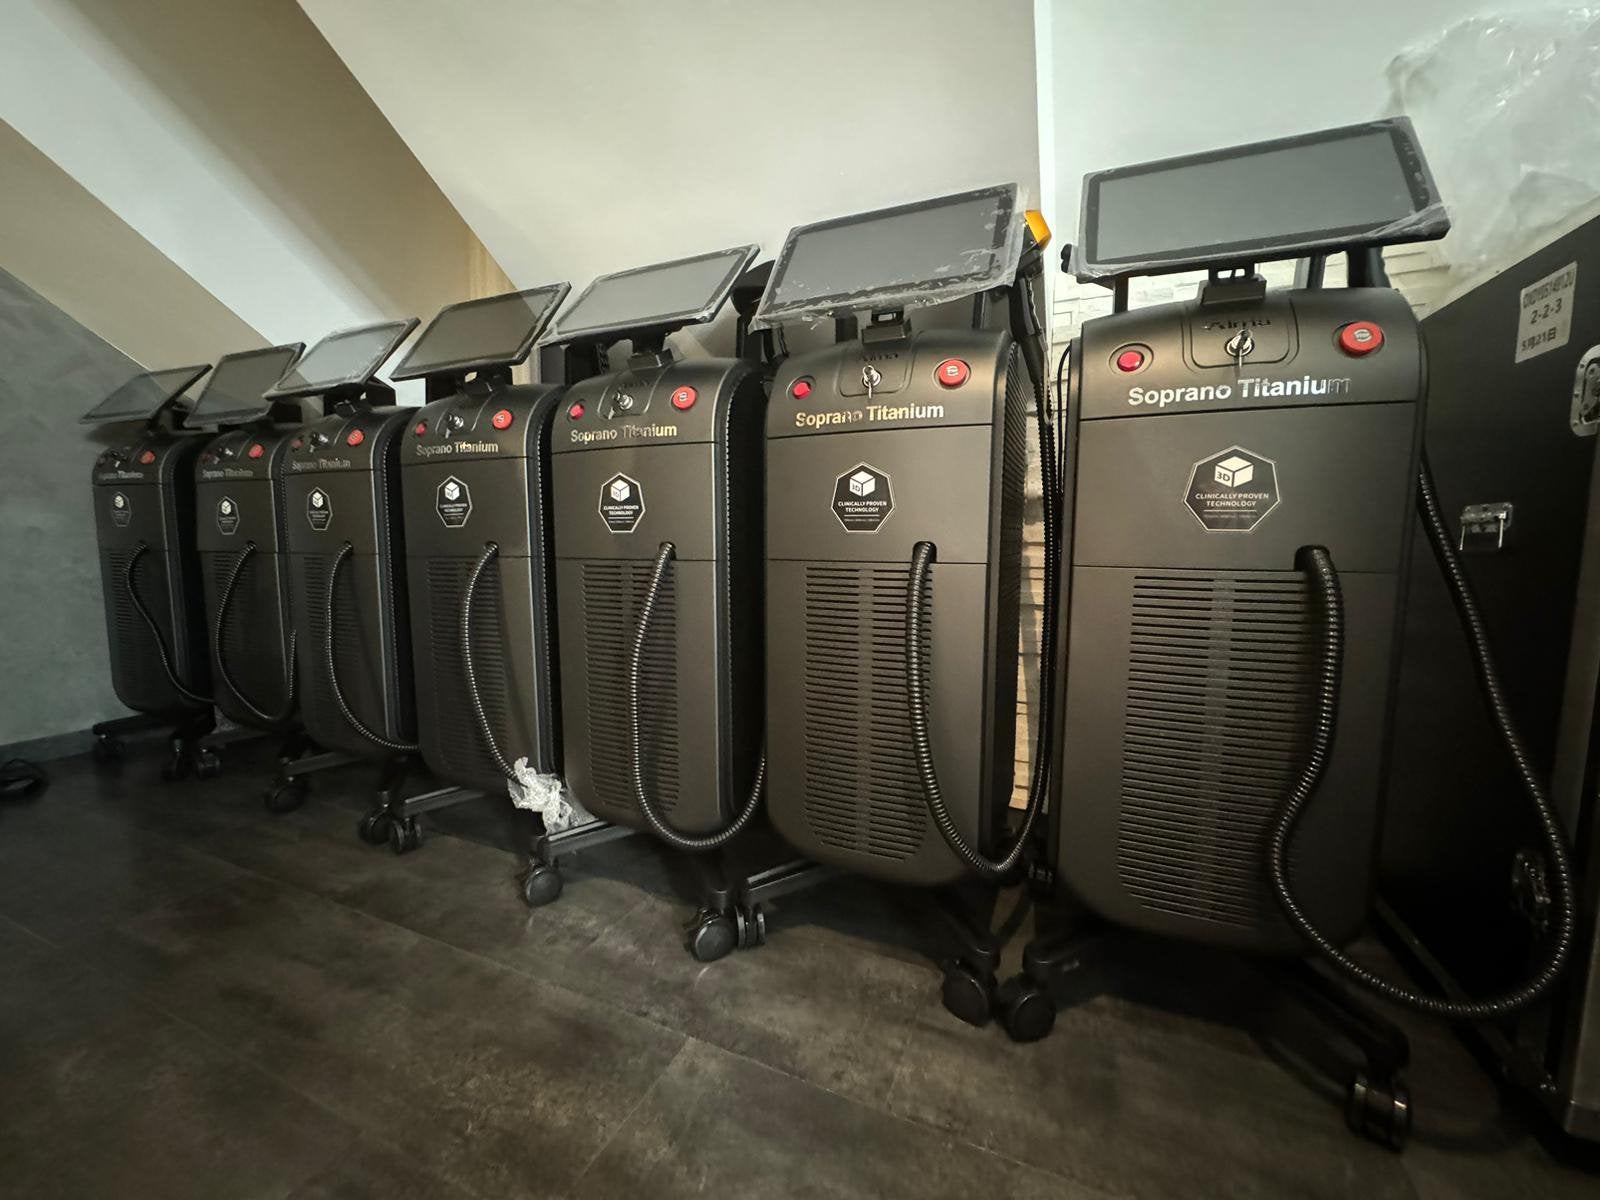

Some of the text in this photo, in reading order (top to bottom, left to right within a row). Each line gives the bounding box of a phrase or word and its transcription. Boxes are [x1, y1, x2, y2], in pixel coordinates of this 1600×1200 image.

[1128, 375, 1351, 408] Soprano Titanium
[795, 402, 944, 429] Soprano Titanium
[570, 423, 678, 445] Soprano Titanium
[454, 440, 499, 453] Titanium
[1216, 471, 1231, 482] 3D
